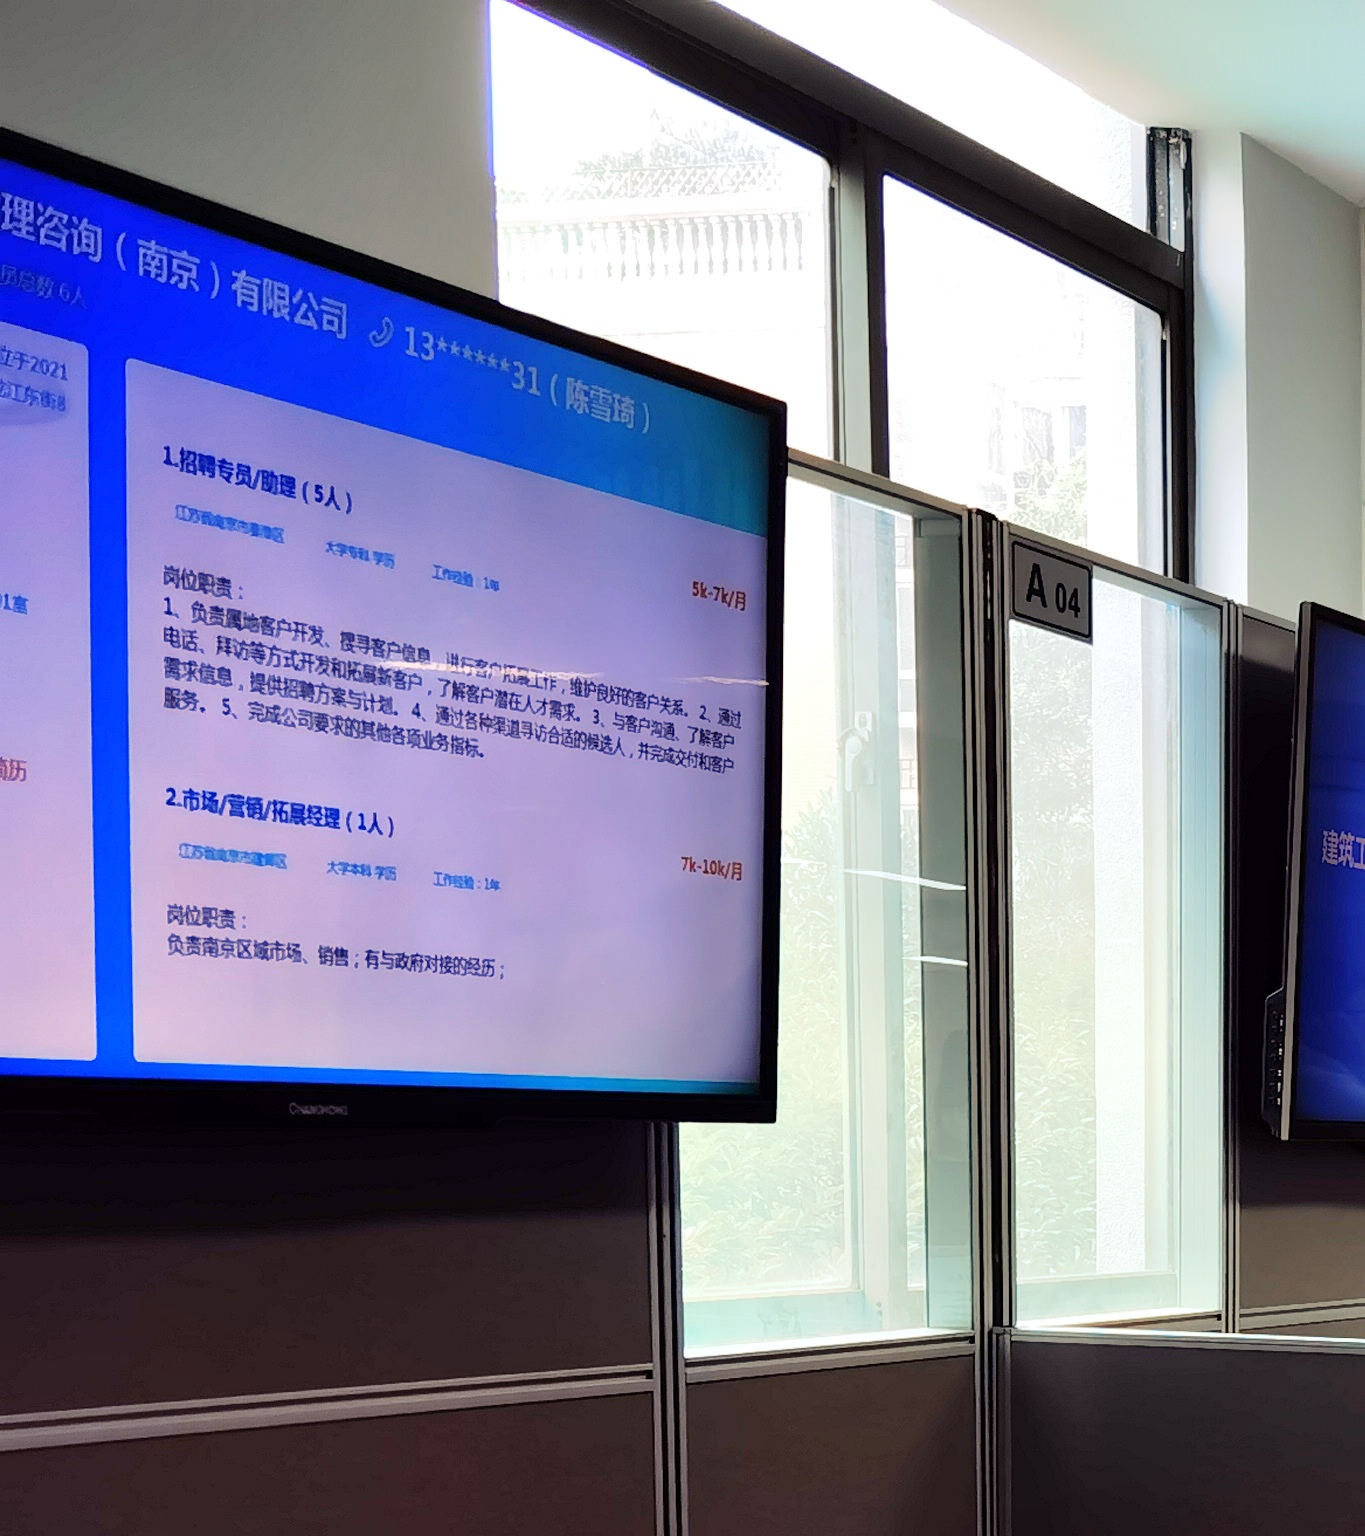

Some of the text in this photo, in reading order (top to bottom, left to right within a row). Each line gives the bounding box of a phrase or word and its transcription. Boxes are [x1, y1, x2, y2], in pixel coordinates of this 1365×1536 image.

[692, 580, 747, 611] 5k-7k/月
[1026, 563, 1081, 618] A 04
[681, 855, 744, 883] 7k-10k/月
[167, 904, 247, 931] 岗位职责：
